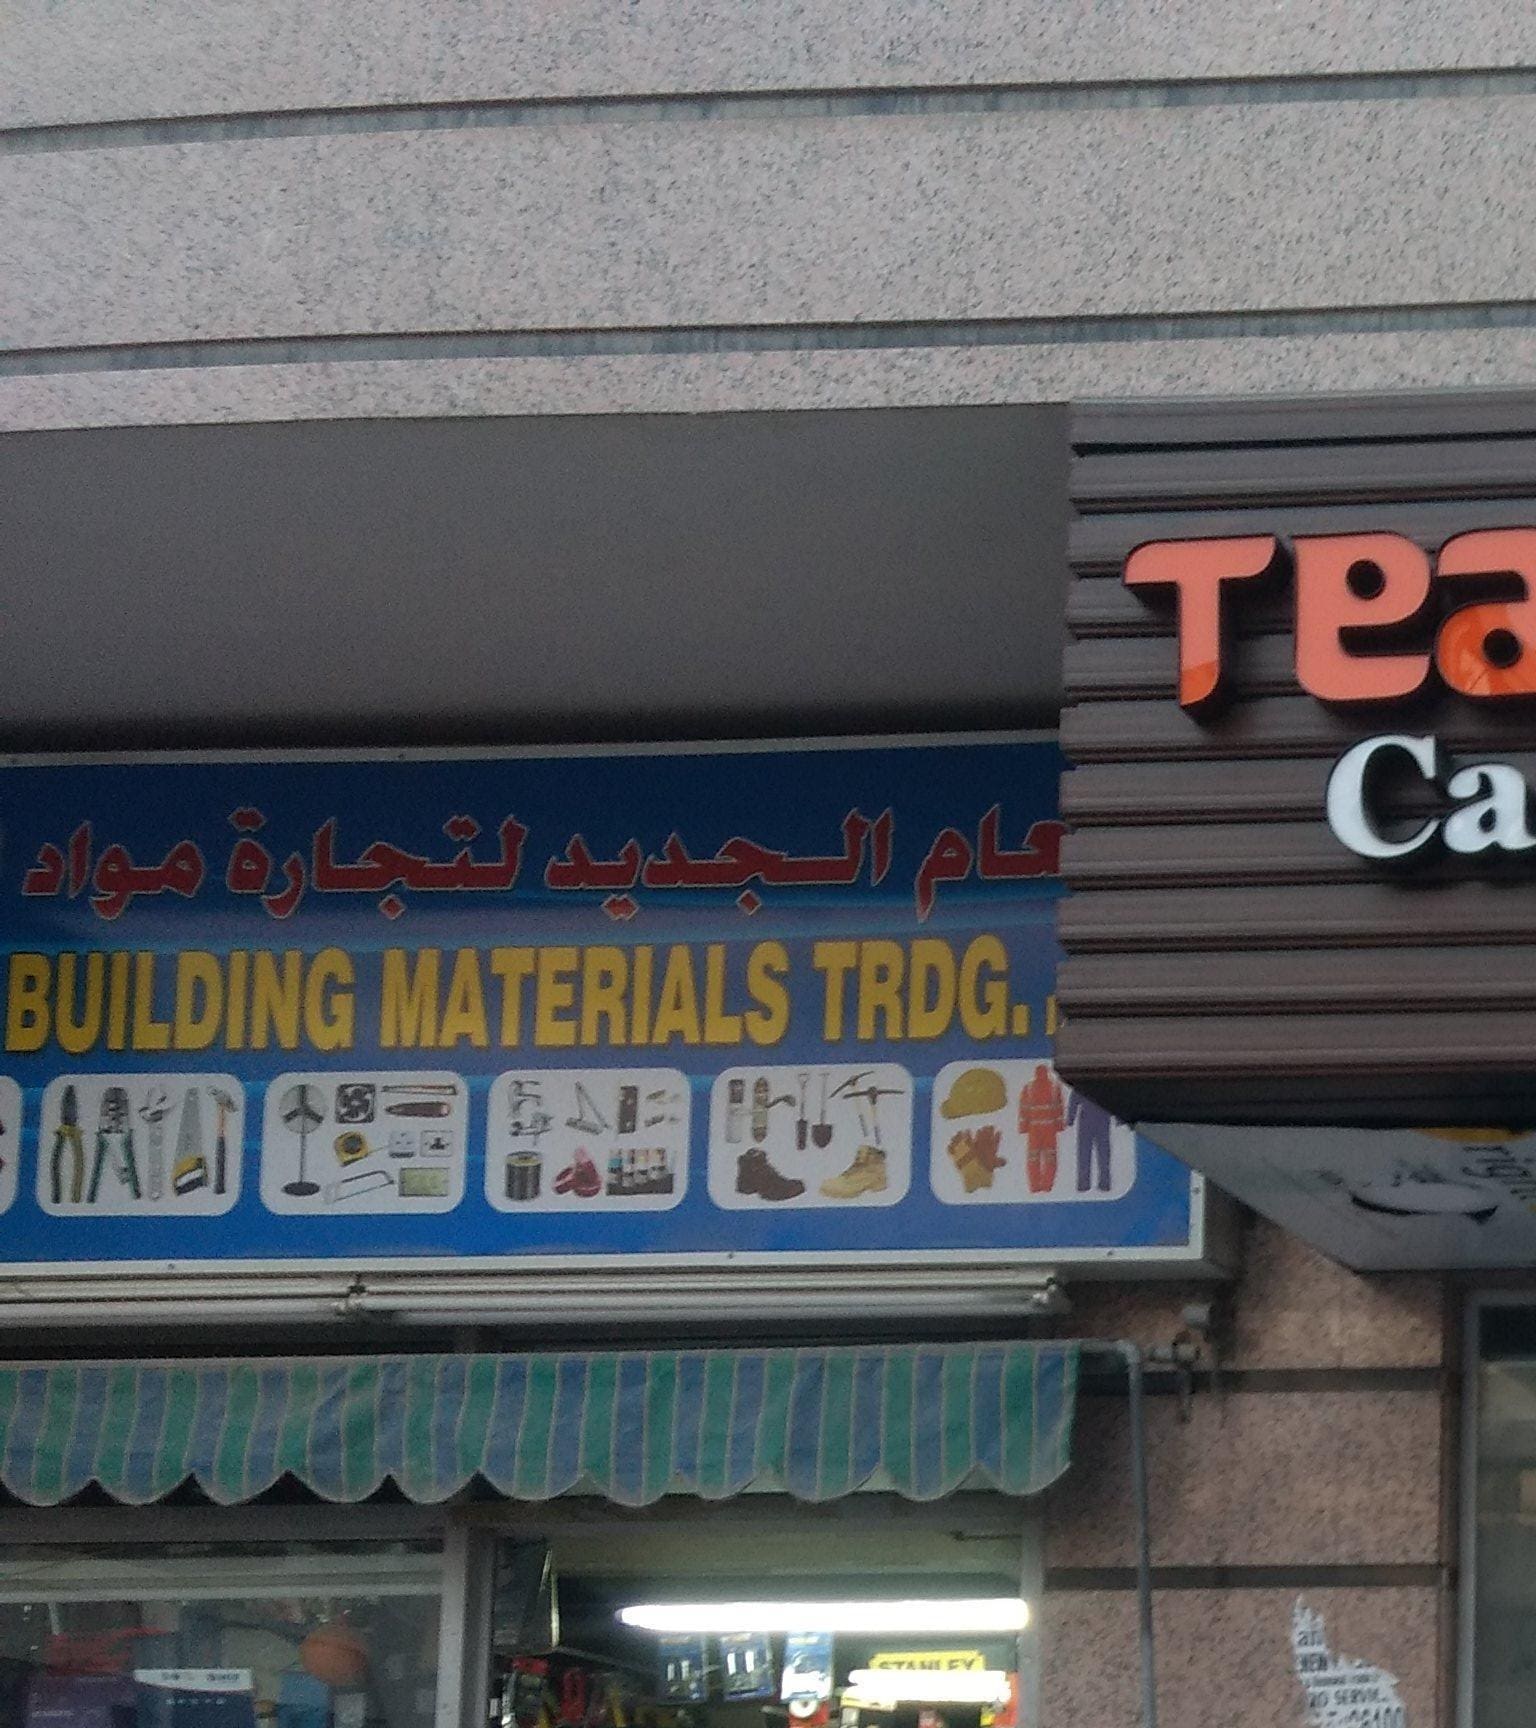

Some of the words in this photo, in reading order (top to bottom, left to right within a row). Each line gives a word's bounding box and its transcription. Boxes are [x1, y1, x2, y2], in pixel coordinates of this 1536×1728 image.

[21, 820, 205, 920] مواد
[226, 806, 529, 920] لتجارة
[544, 806, 894, 921] الجديد
[4, 945, 356, 1054] BUILDING
[379, 940, 791, 1048] MATERIALS
[812, 933, 1031, 1045] TRDG.
